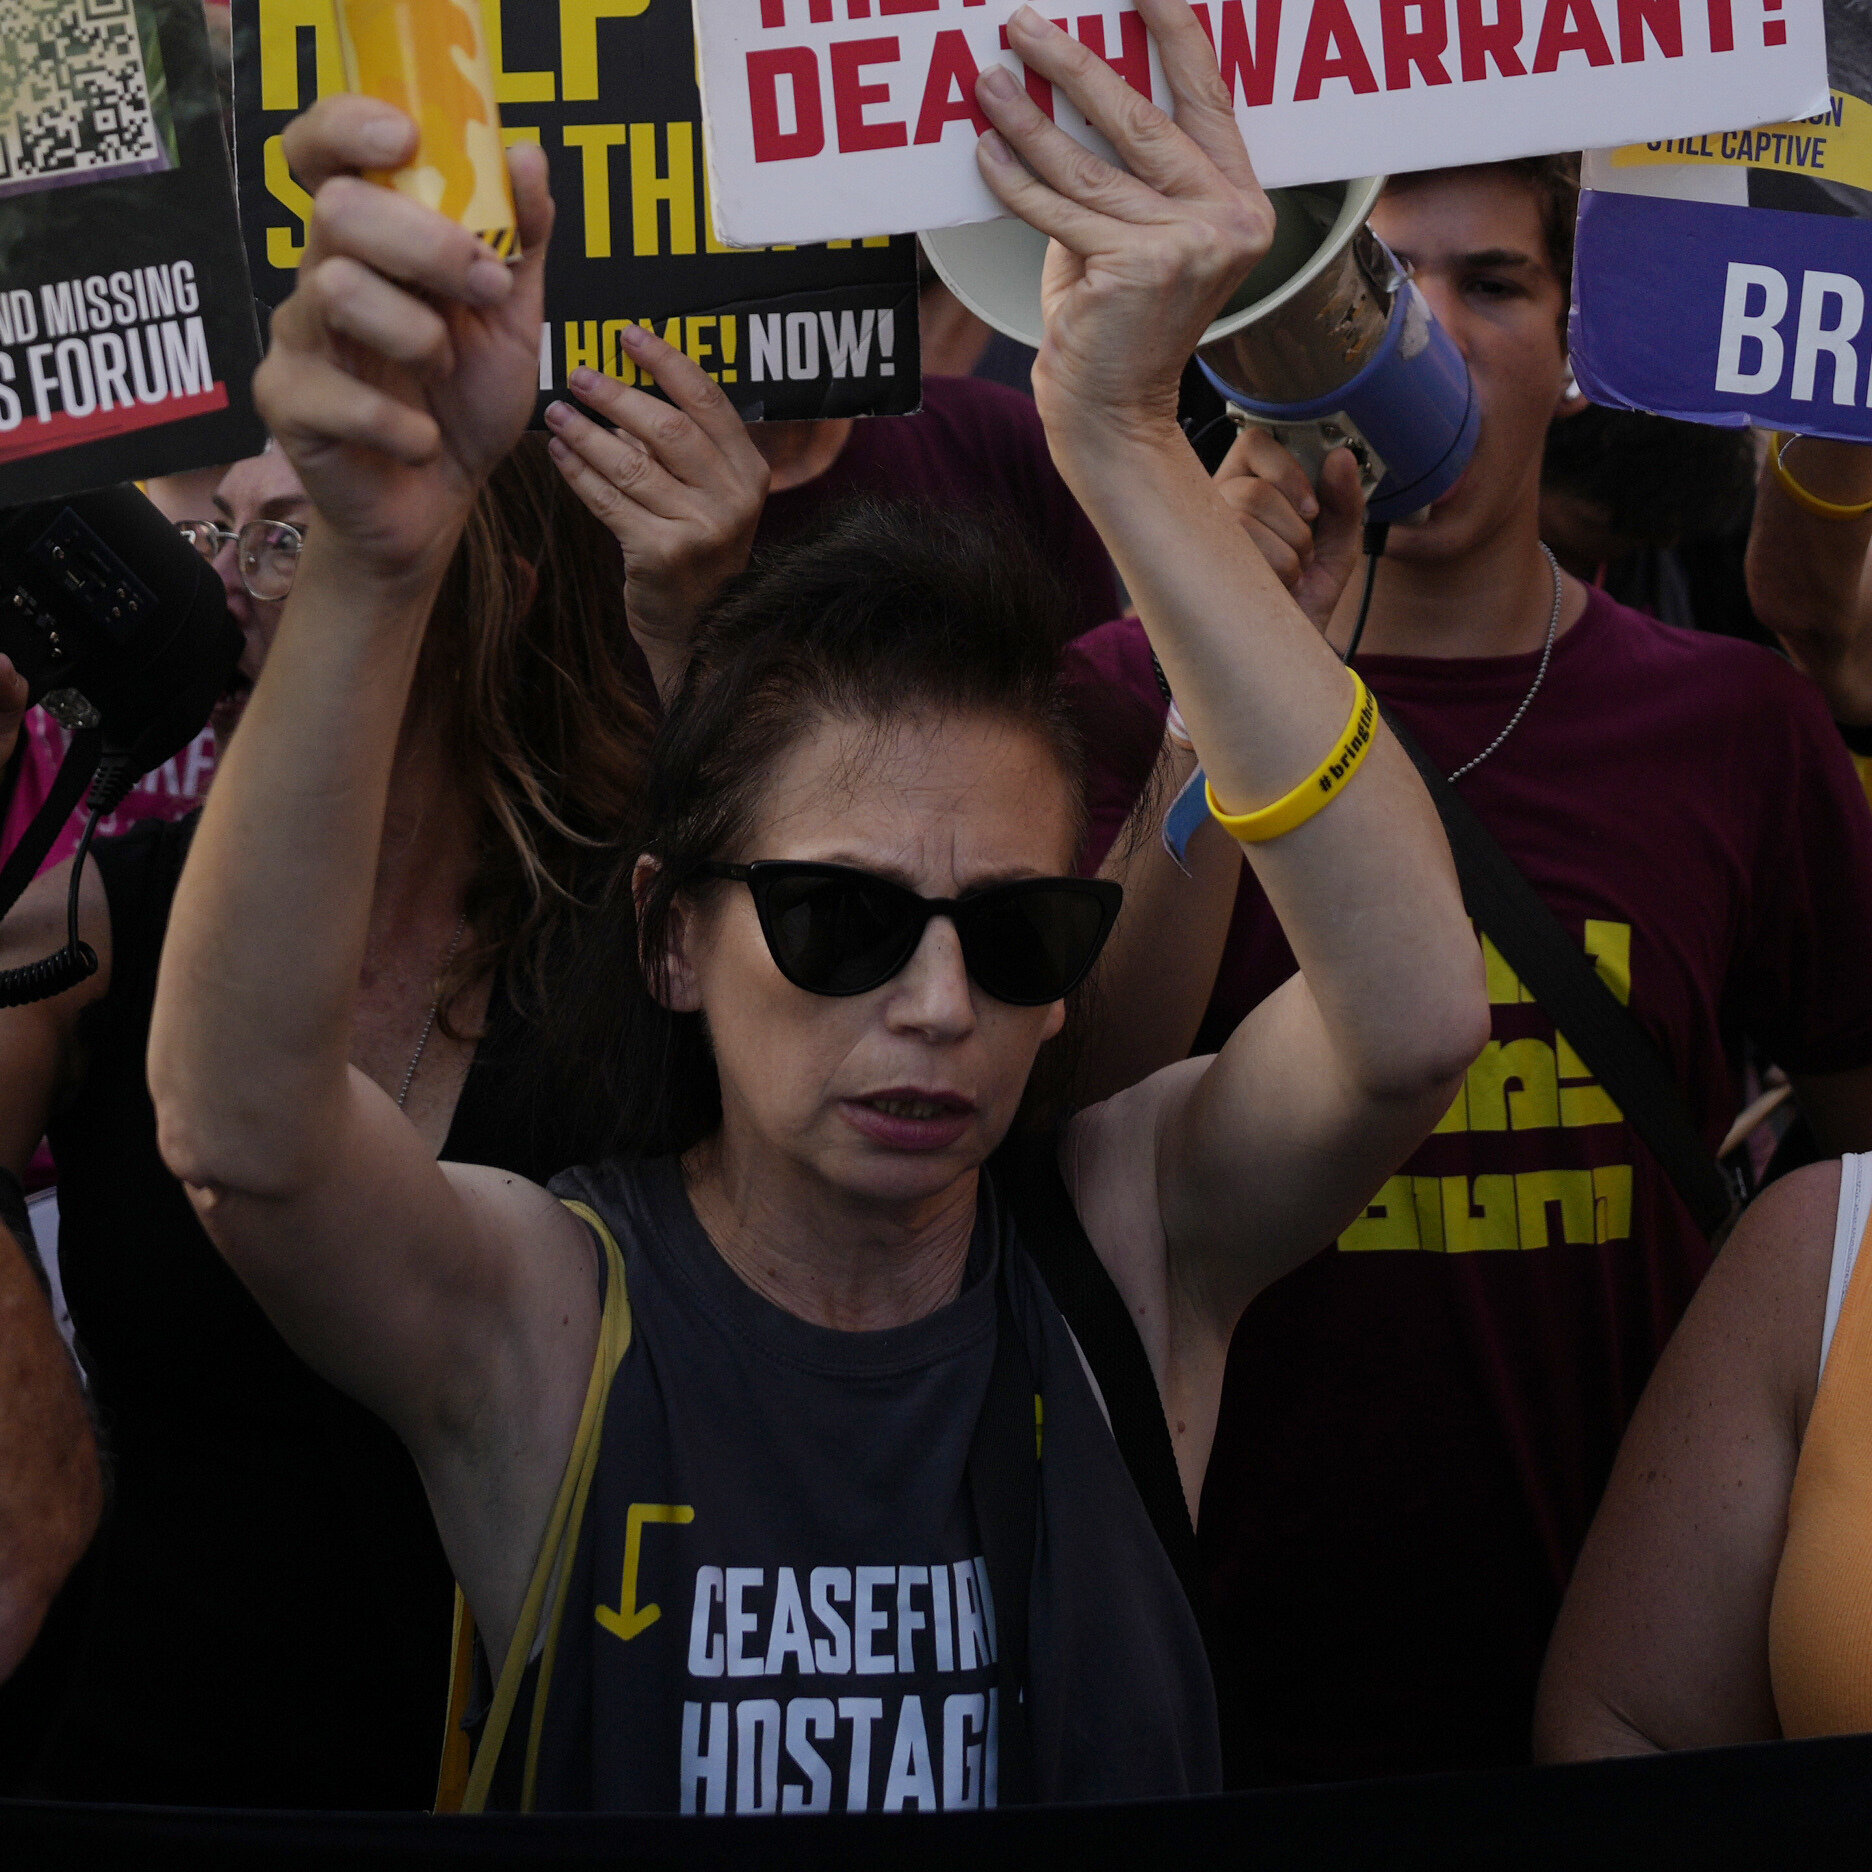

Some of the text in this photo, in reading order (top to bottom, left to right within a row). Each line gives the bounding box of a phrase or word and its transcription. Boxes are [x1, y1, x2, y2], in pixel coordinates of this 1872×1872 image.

[1721, 130, 1827, 169] CAPTIVE
[39, 259, 200, 336] MISSING
[28, 316, 214, 426] FORUM
[748, 309, 895, 382] NOW!
